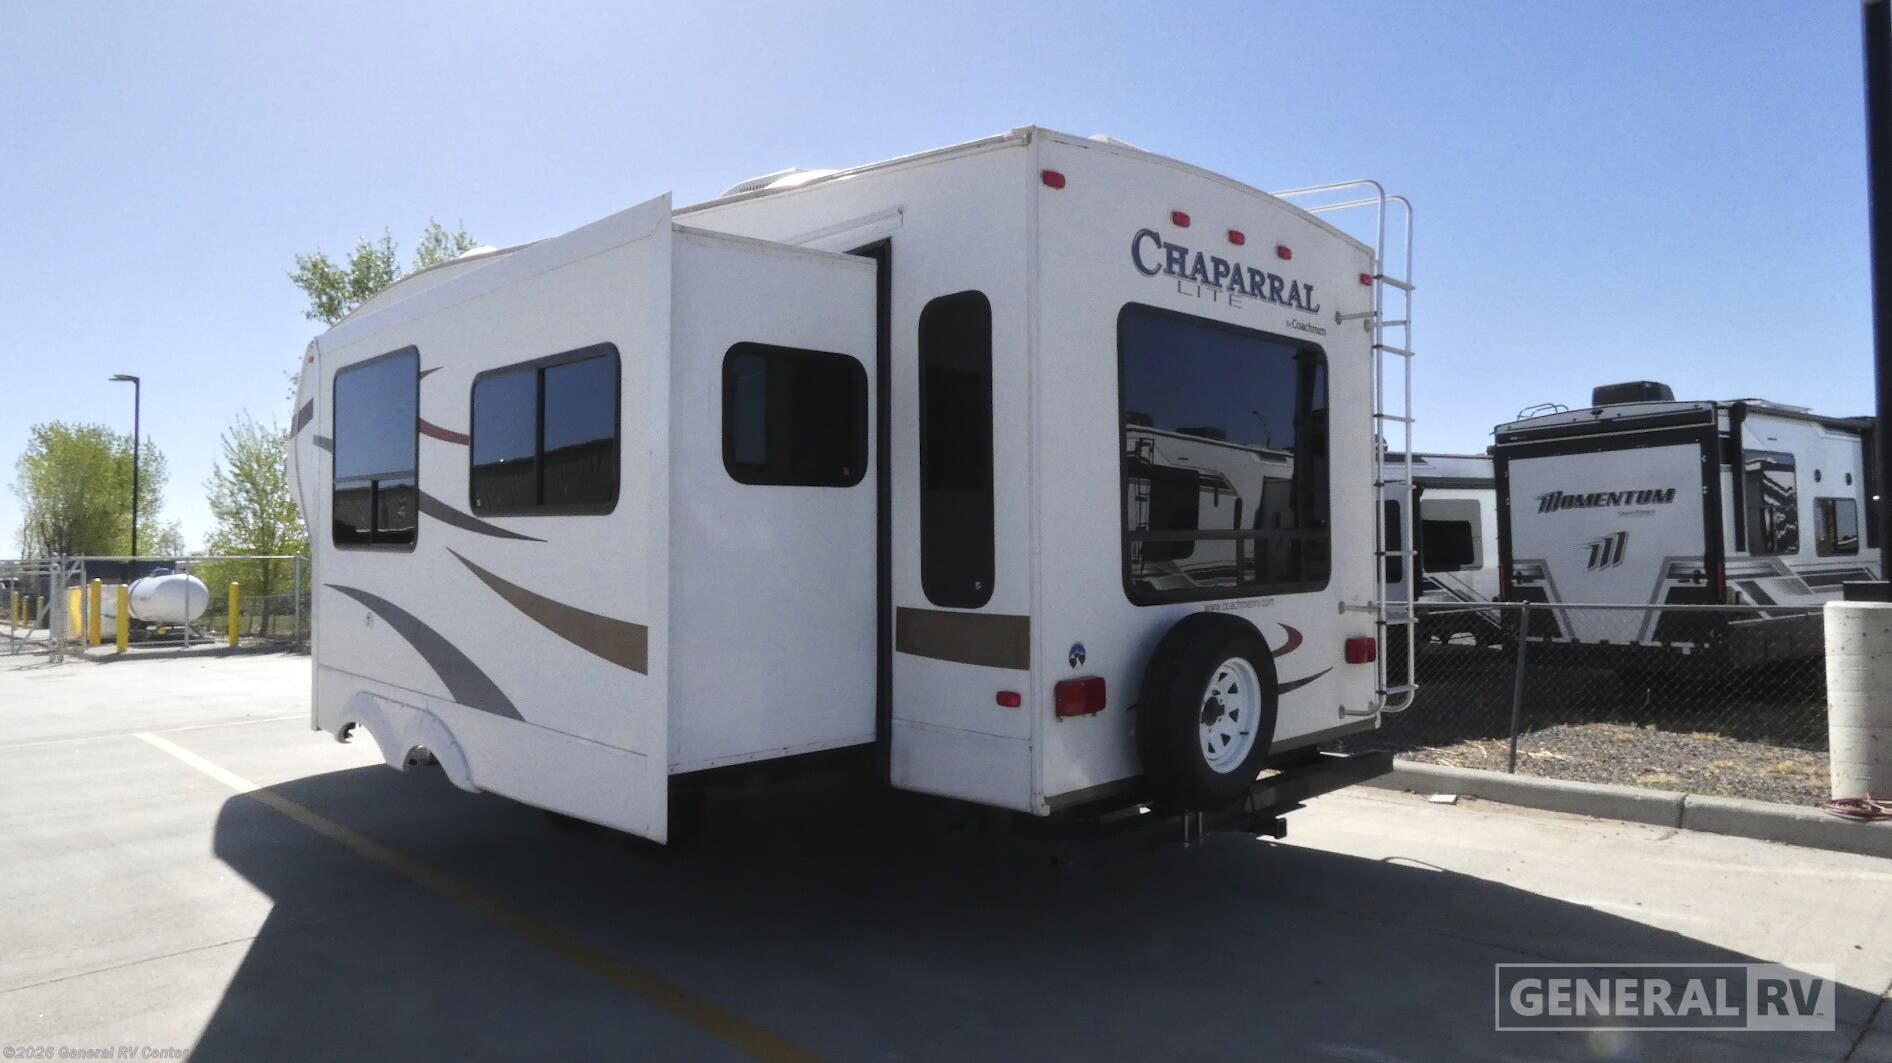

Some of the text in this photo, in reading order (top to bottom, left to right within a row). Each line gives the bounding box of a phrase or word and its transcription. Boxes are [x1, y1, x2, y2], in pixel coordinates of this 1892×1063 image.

[1131, 228, 1320, 313] CHAPARRAL
[1178, 280, 1244, 309] LITE
[1537, 488, 1677, 514] MOMENTUM
